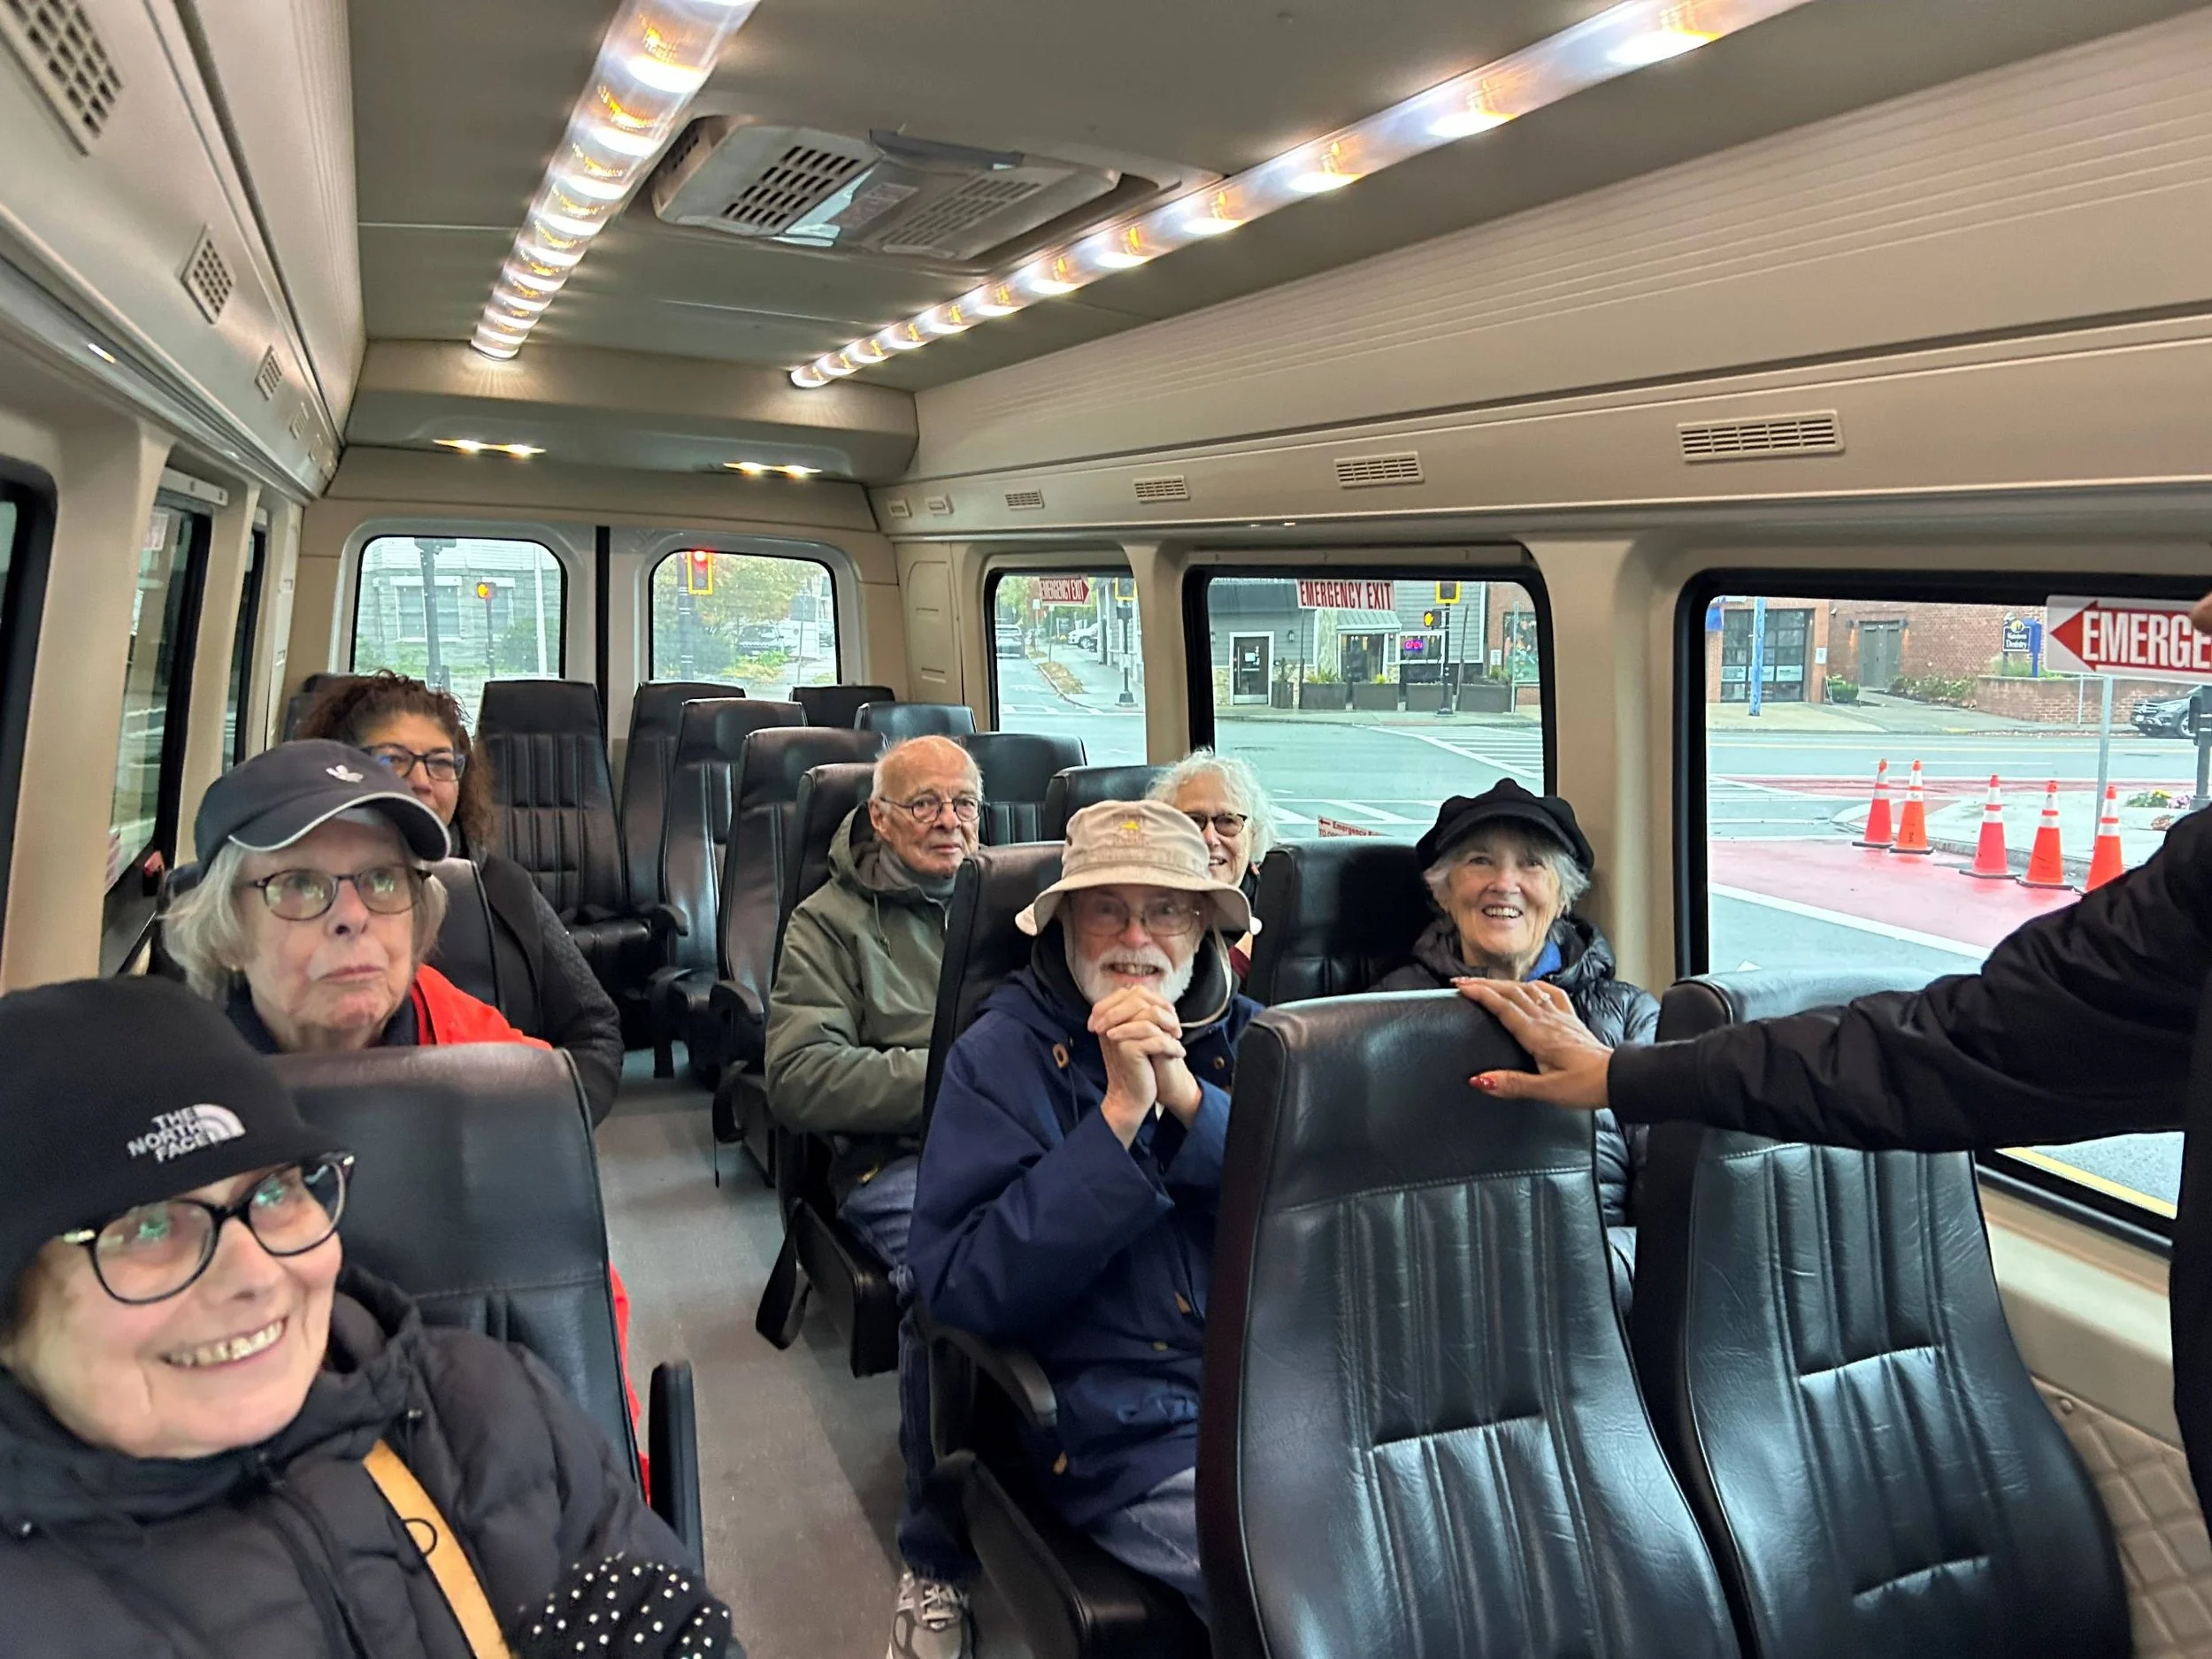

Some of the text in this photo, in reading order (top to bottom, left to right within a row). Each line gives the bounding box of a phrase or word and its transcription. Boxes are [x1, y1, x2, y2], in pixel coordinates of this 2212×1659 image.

[1040, 580, 1084, 600] EMERGENCY EXIT
[1300, 580, 1391, 610] EMERGENCY EXIT
[151, 1108, 196, 1129] THE
[127, 1119, 205, 1157] NORTH
[155, 1133, 211, 1163] FACE
